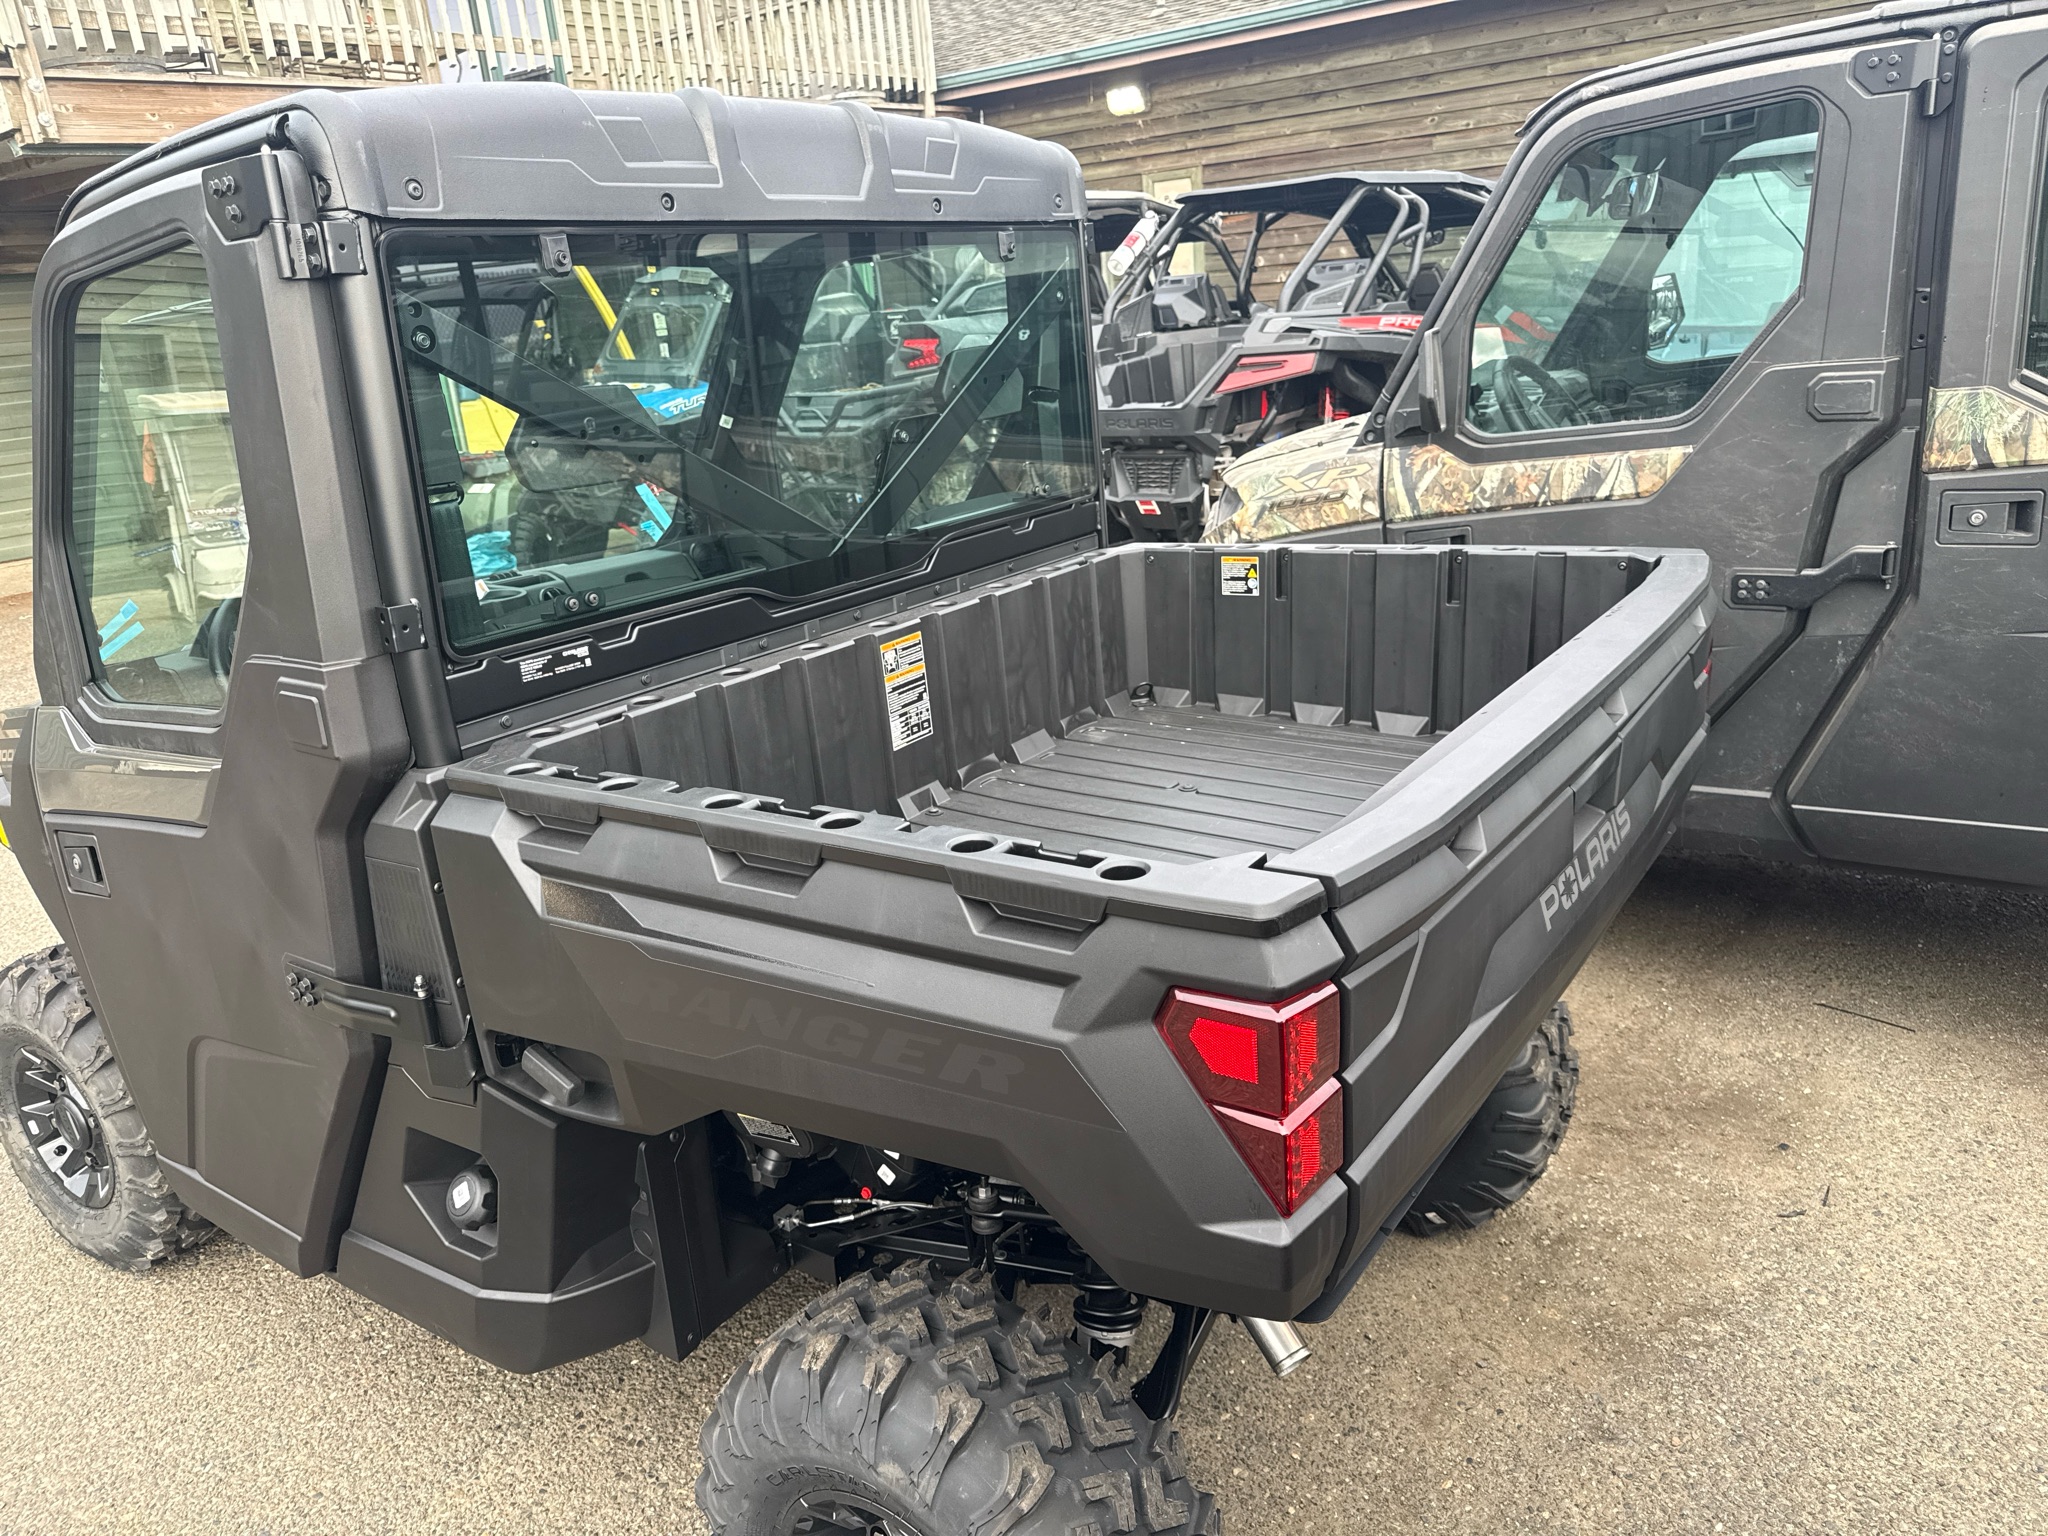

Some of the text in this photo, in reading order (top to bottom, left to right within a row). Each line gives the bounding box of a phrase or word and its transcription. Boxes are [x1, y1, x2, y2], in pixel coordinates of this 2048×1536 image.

[1105, 418, 1174, 430] POLARIS
[1256, 462, 1374, 501] XP
[1267, 489, 1348, 512] 1000
[1539, 798, 1632, 933] POLARIS
[618, 974, 1026, 1095] RANGER
